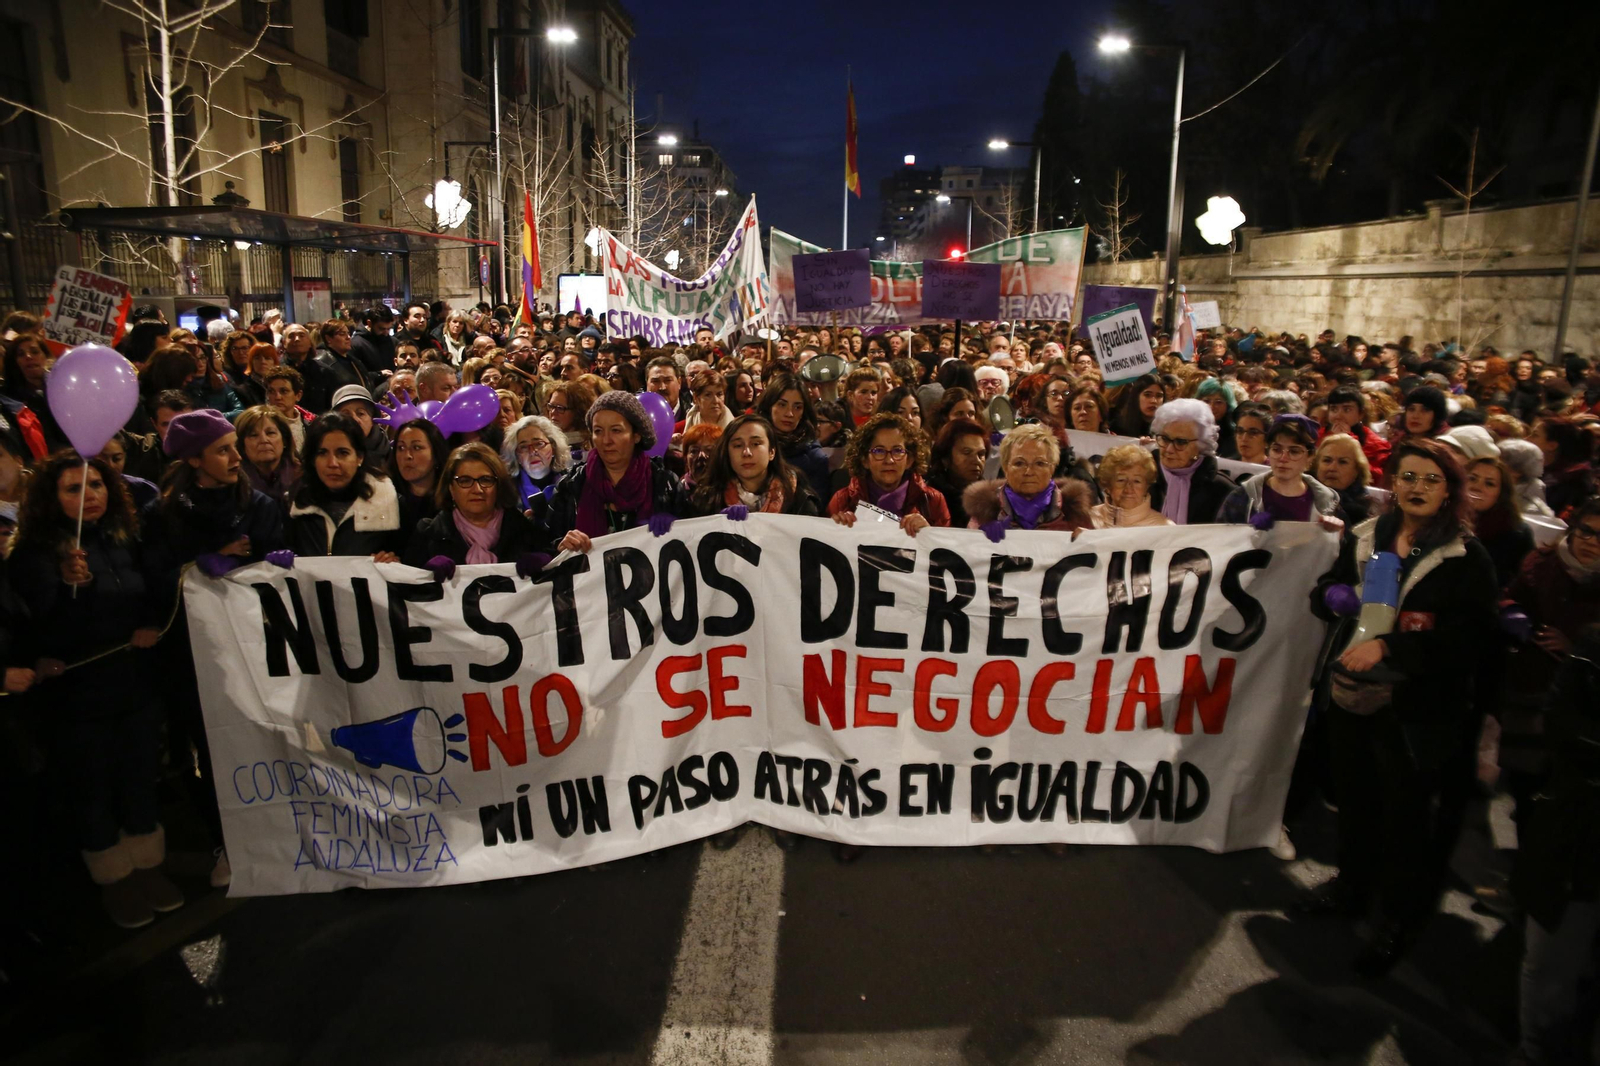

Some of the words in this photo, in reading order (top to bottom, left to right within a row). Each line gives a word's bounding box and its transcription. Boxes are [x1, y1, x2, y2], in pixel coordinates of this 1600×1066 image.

[609, 237, 651, 281] LAS
[801, 264, 856, 281] IGUALDAD
[814, 253, 838, 267] SIN
[609, 277, 624, 296] LA
[803, 294, 854, 309] JUSTICIA
[811, 283, 826, 293] NO
[833, 281, 851, 291] HAY
[1096, 316, 1143, 359] ¡Igualdad!
[251, 531, 761, 684] NUESTROS
[800, 538, 1272, 657] DERECHOS
[461, 672, 585, 772] NO
[655, 645, 753, 738] SE
[803, 650, 1236, 736] NEGOCIAN
[233, 759, 462, 811] COORDINADORA
[545, 776, 610, 840] UN
[628, 751, 740, 830] PASO
[753, 752, 887, 820] ATRÁS
[900, 762, 954, 817] EN
[292, 800, 444, 845] FEMINISTA
[293, 836, 460, 873] ANDALUZA
